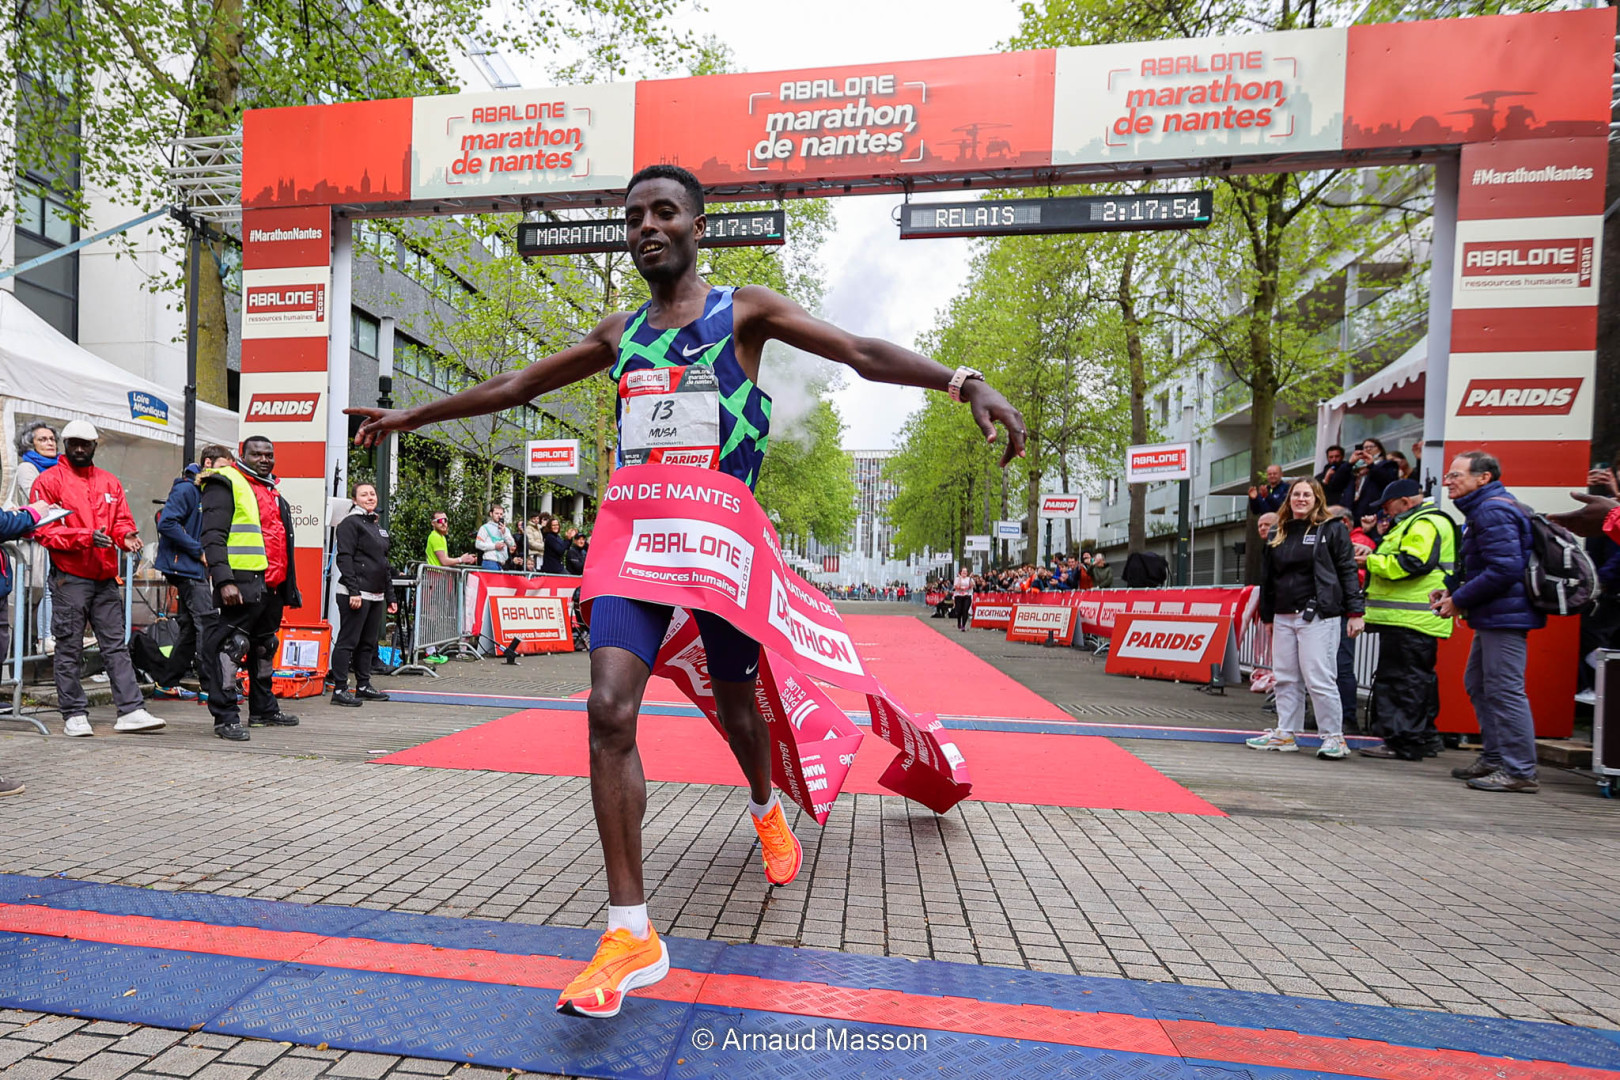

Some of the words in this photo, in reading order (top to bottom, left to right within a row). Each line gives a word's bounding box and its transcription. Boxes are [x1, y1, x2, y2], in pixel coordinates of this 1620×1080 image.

[1141, 51, 1262, 76] ABALONE
[780, 74, 894, 101] ABALONE
[1126, 74, 1284, 108] marathon
[472, 102, 565, 124] ABALONE
[765, 98, 914, 133] marathon
[1113, 108, 1153, 135] de
[1162, 105, 1271, 132] nantes
[460, 122, 582, 151] marathon
[754, 131, 792, 160] de
[801, 127, 903, 157] nantes
[452, 151, 483, 175] de
[489, 148, 573, 173] nantes
[1472, 165, 1593, 185] #MarathonNantes
[935, 206, 1015, 228] RELAIS
[1103, 198, 1200, 221] 2:17:54
[249, 227, 322, 242] #MarathonNantes
[536, 224, 626, 246] MARATHON
[705, 217, 775, 237] :17:54
[1466, 247, 1576, 268] ABALONE
[1581, 246, 1592, 281] GROUP
[1465, 278, 1522, 287] ressources
[1524, 276, 1573, 286] humaines
[249, 291, 314, 306] ABALONE
[248, 314, 282, 322] ressources
[283, 313, 314, 321] humaines
[133, 392, 150, 405] Loire
[1465, 387, 1574, 407] PARIDIS
[133, 402, 166, 419] Atlantique
[250, 400, 314, 416] PARIDIS
[651, 400, 675, 421] 13
[648, 427, 677, 438] MUSA
[532, 450, 568, 459] ABALONE
[664, 455, 709, 465] PARIDIS
[1133, 453, 1179, 465] ABALONE
[638, 484, 661, 498] DE
[666, 484, 741, 513] NANTES
[634, 532, 741, 570] ABALONE
[625, 566, 689, 582] ressources
[691, 571, 737, 596] humaines
[740, 556, 751, 598] GROUP
[502, 607, 555, 620] ABALONE
[977, 609, 1011, 618] DECATHLON
[1017, 612, 1062, 623] ABALONE
[1126, 631, 1206, 651] PARIDIS
[754, 689, 776, 723] NANTES
[781, 688, 800, 708] PAYS
[778, 740, 795, 777] ABALONE
